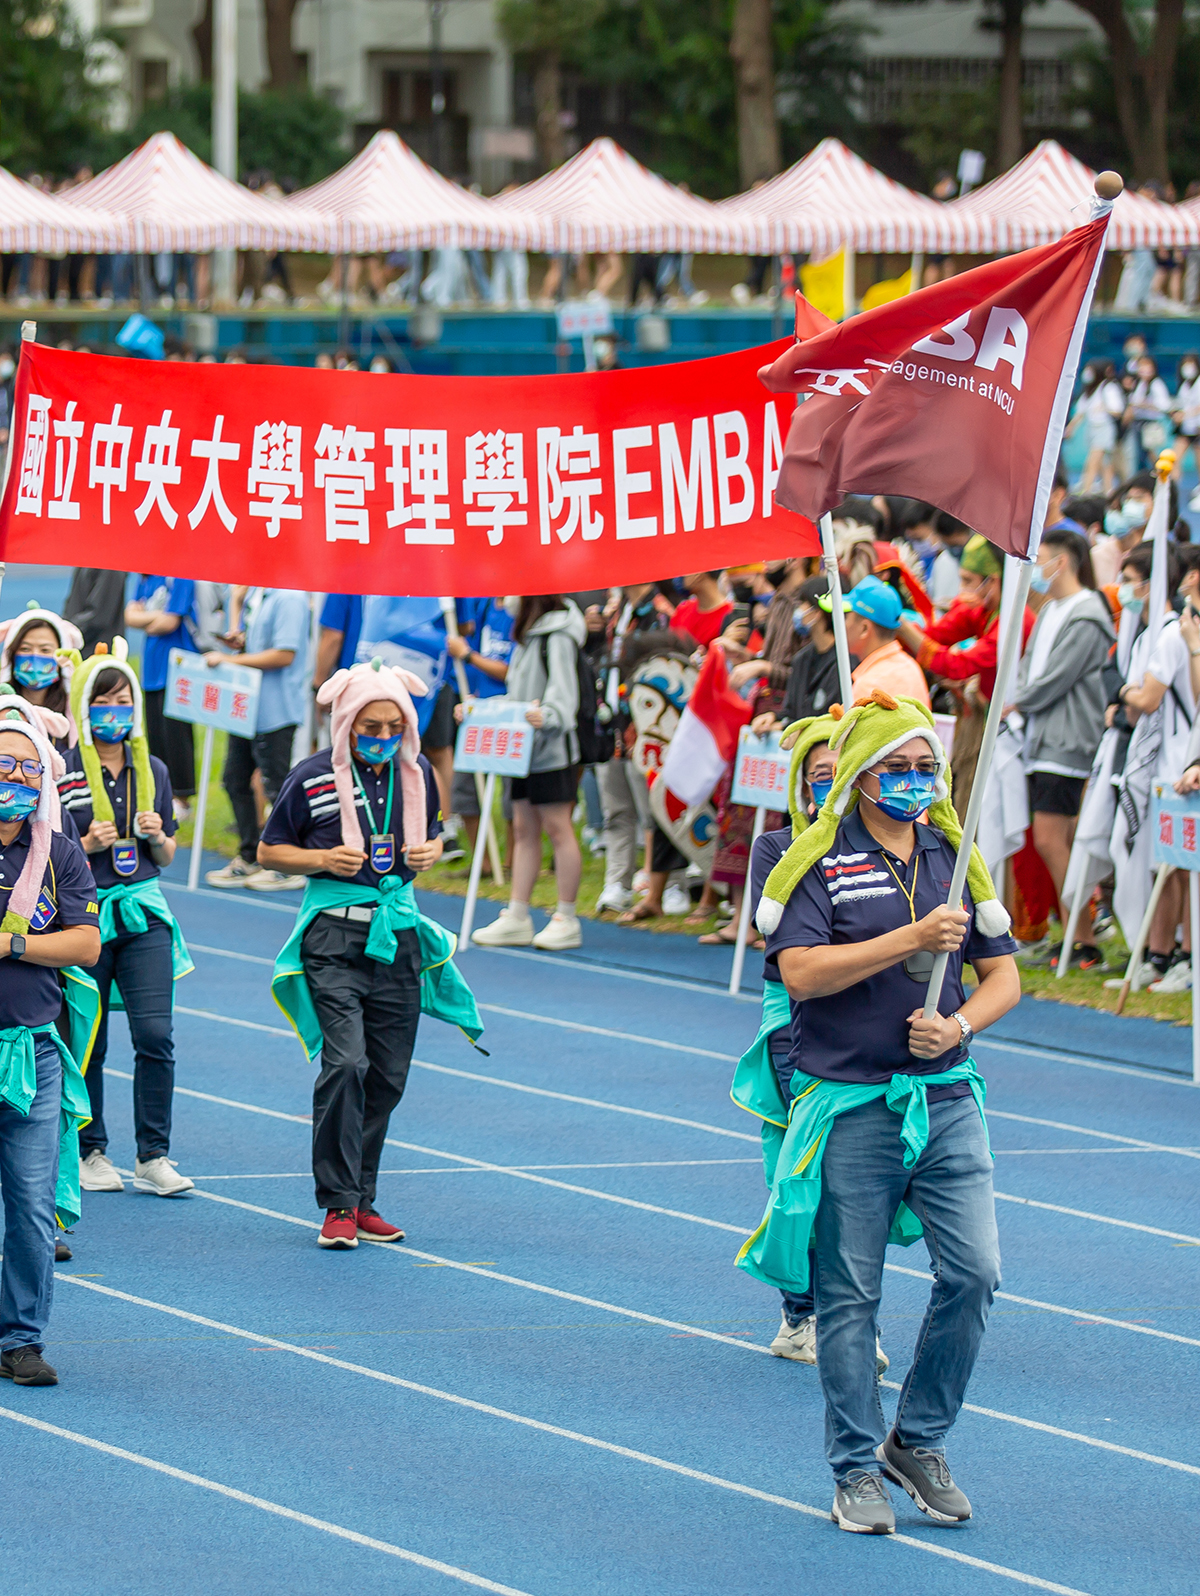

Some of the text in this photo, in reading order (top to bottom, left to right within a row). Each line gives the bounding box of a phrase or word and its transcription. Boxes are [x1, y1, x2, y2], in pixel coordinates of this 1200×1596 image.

[888, 359, 976, 393] agement
[978, 382, 994, 400] at
[993, 386, 1015, 416] NCU
[14, 393, 785, 546] 國立中央大學管理學院EMBA
